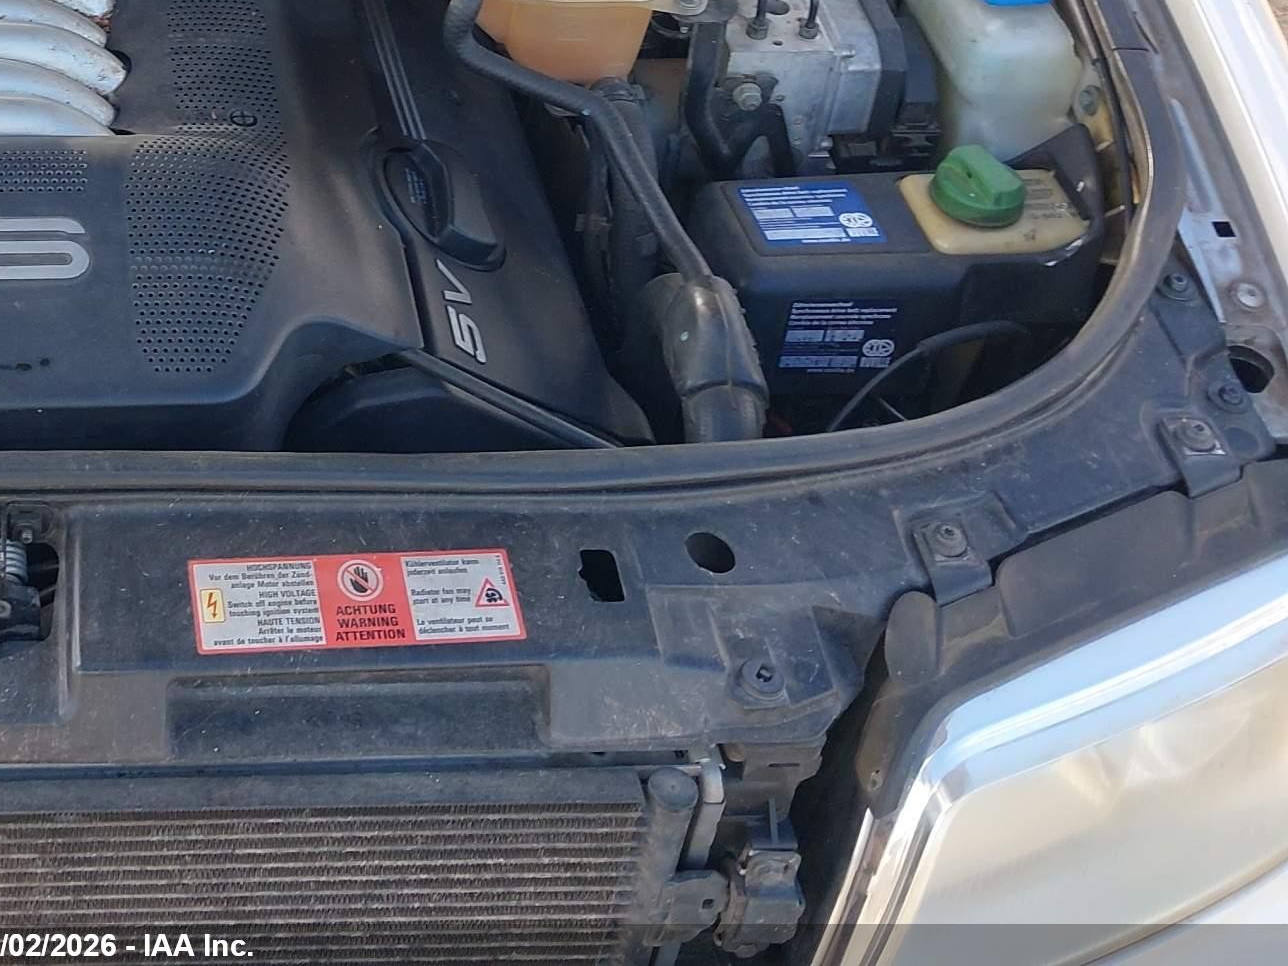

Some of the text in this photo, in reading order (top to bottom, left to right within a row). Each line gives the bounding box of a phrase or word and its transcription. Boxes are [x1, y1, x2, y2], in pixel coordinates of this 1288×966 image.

[436, 258, 487, 364] 5V
[246, 562, 312, 571] HOCHSPANNUNG
[259, 589, 316, 599] HIGH VOLTAGE
[227, 600, 253, 608] Switch
[268, 600, 291, 608] engine
[229, 610, 260, 618] touching
[263, 609, 290, 617] ignition
[336, 604, 396, 615] ACHTUNG
[258, 616, 320, 626] HAUTE TENSION
[337, 617, 398, 628] WARNING
[336, 629, 405, 641] ATTENTION
